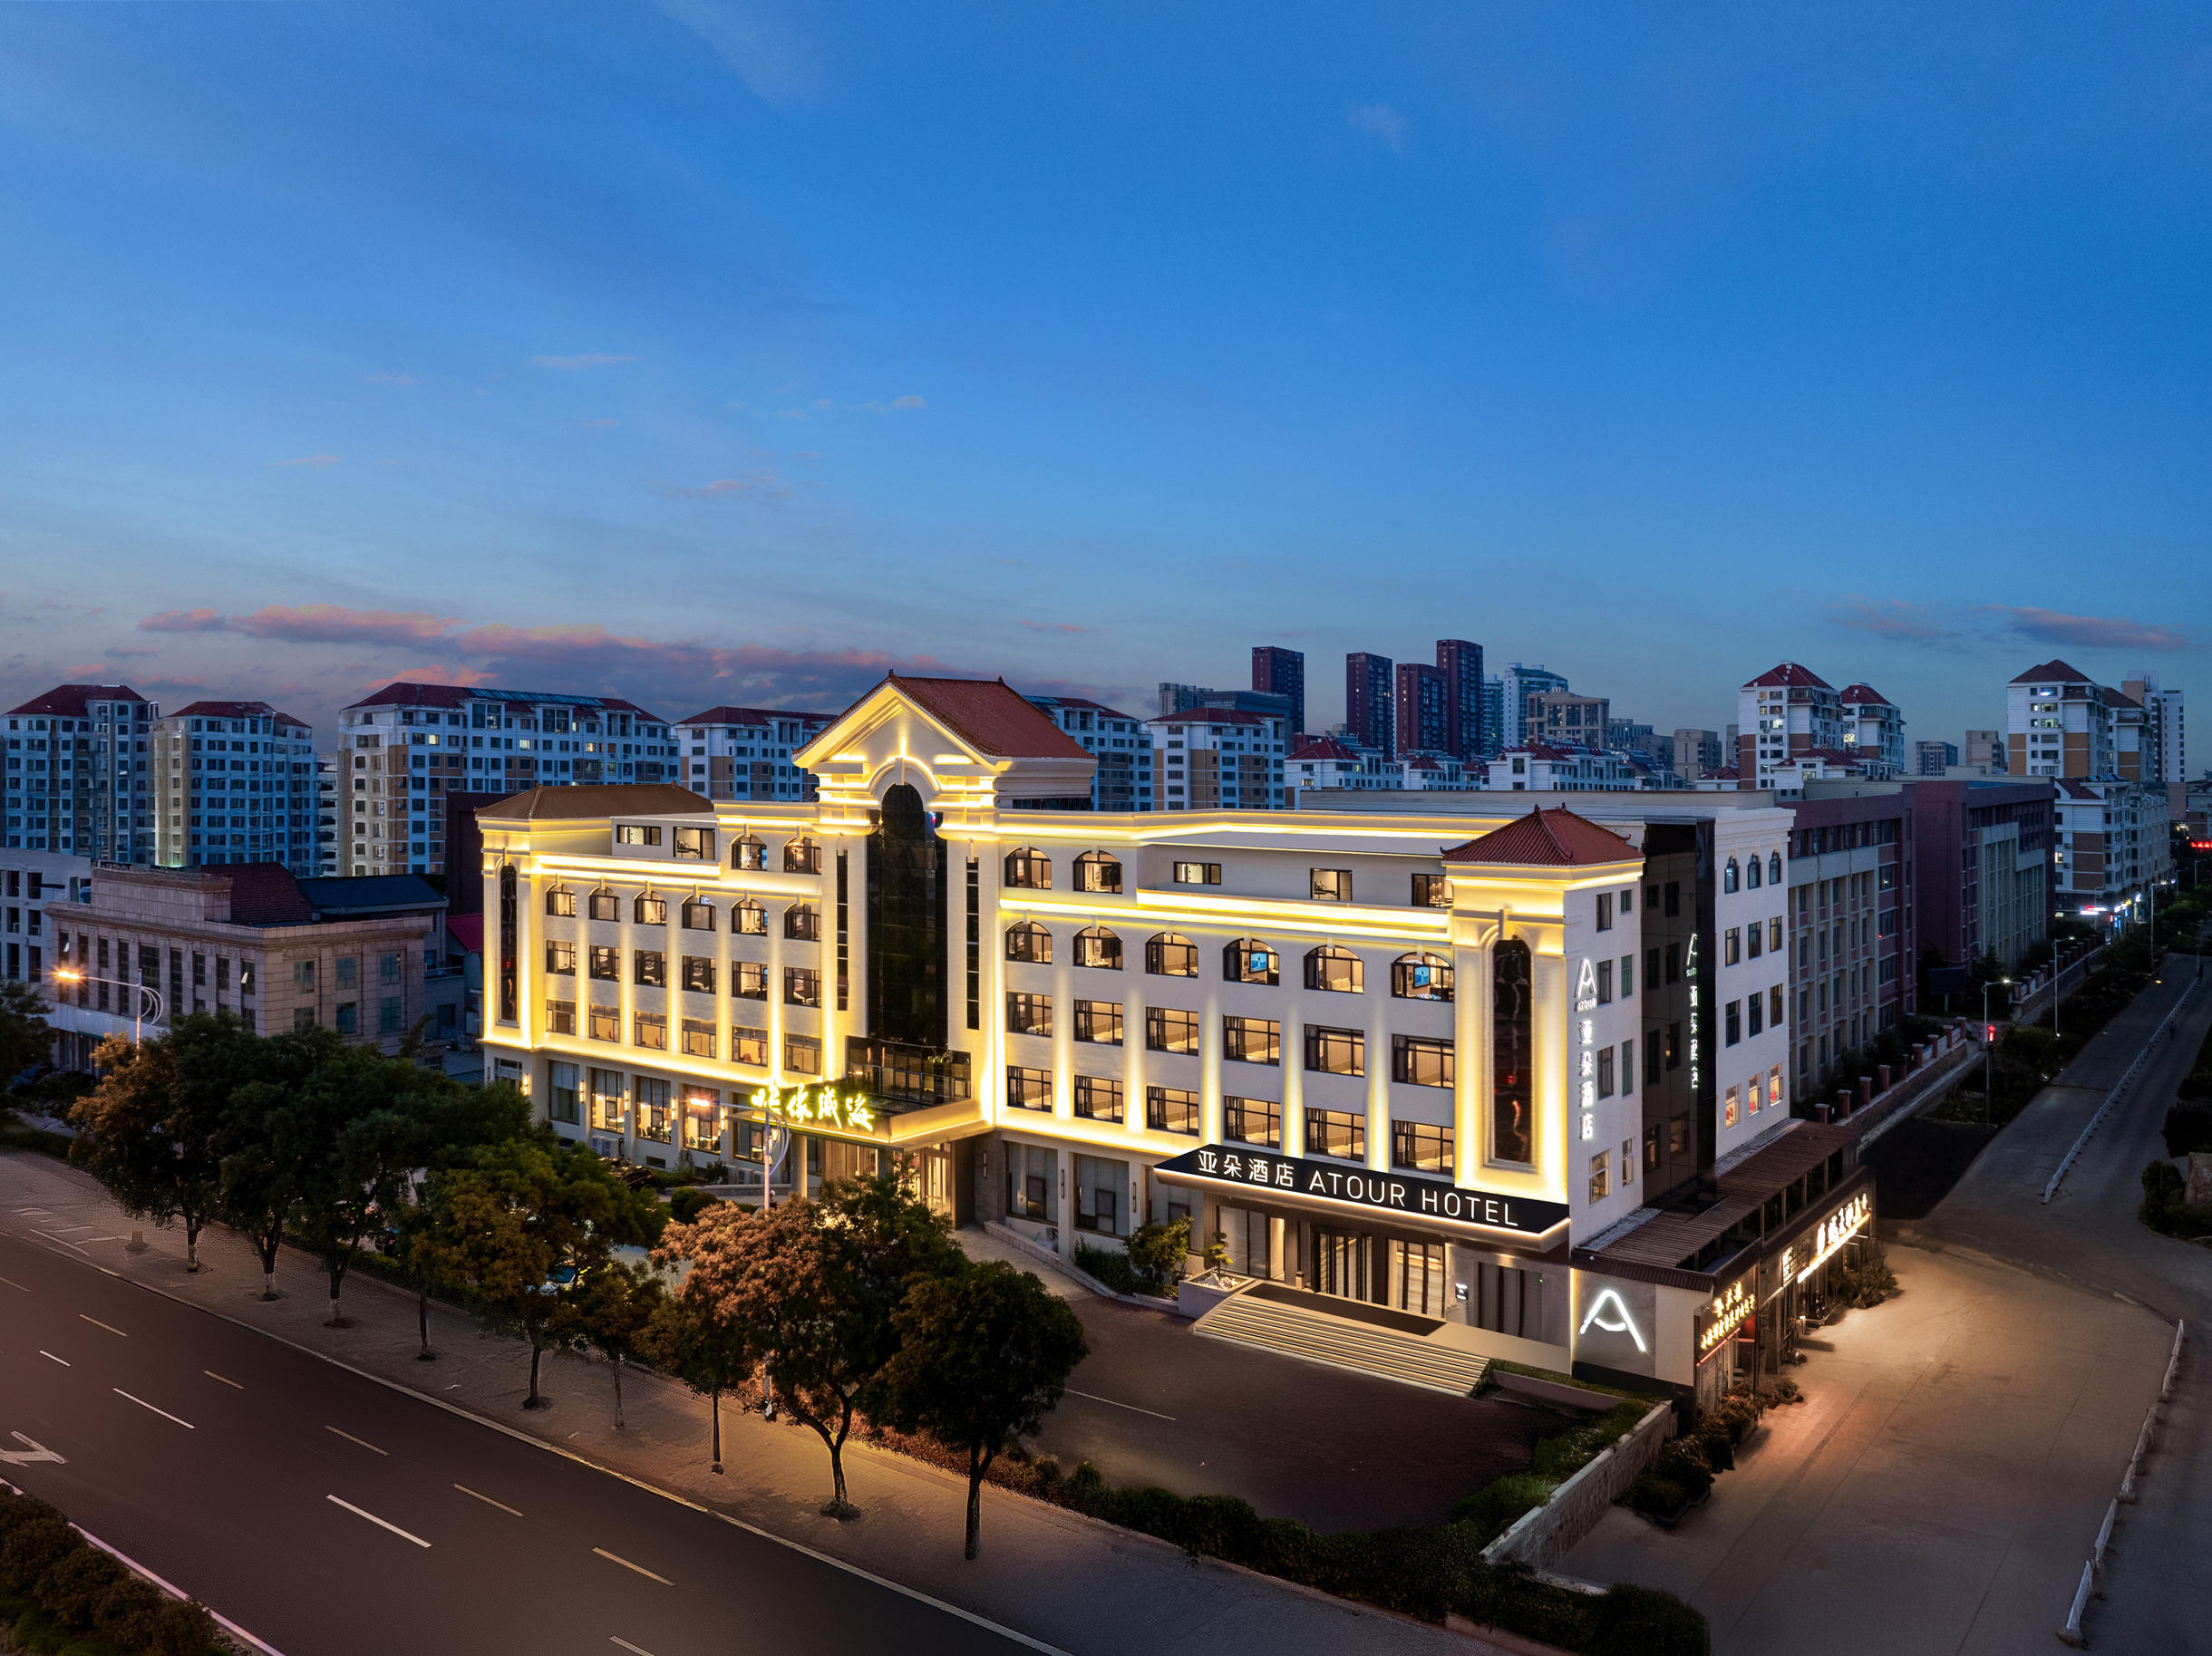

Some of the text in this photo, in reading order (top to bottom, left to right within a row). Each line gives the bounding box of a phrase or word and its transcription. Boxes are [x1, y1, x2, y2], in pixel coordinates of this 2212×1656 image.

[1198, 1149, 1518, 1226] 亚朵酒店 ATOUR HOTEL
